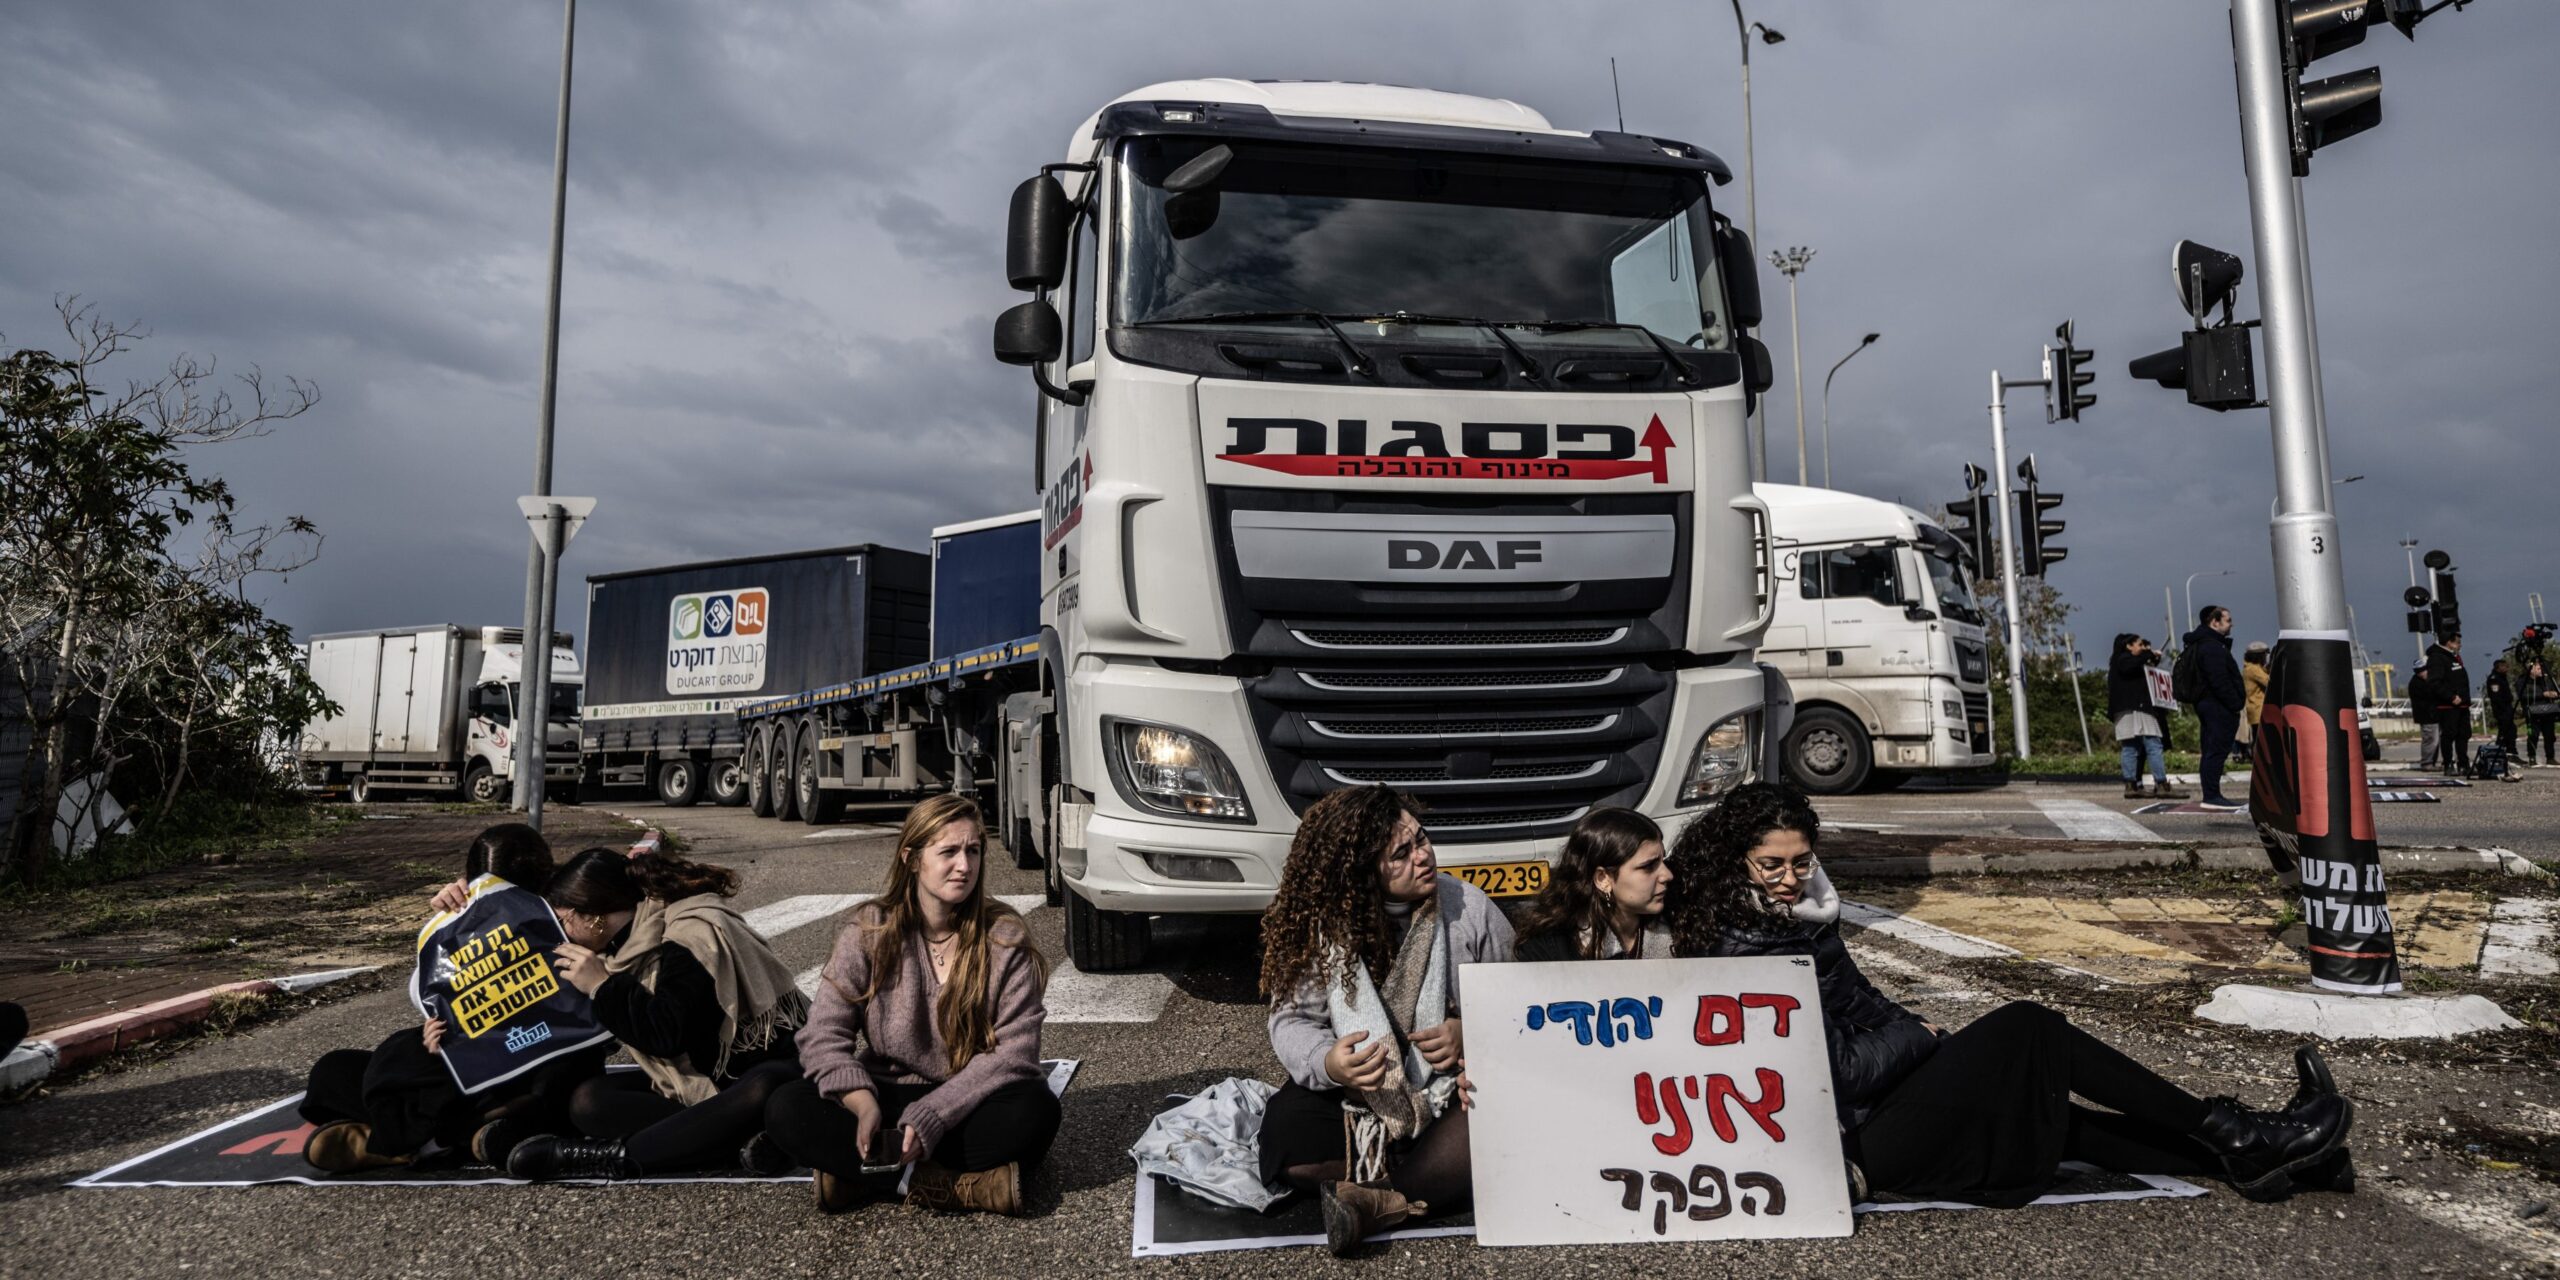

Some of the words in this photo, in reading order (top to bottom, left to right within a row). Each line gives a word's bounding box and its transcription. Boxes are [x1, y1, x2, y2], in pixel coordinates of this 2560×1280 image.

[1226, 418, 1636, 460] פסגות
[1337, 459, 1462, 476] והובלה
[1481, 463, 1570, 478] מינוף
[1387, 540, 1543, 570] DAF
[2311, 536, 2324, 554] 3
[670, 647, 715, 672] דוקרט
[720, 643, 766, 668] קבוצת
[677, 675, 717, 688] DUCART
[720, 674, 754, 686] GROUP
[485, 923, 513, 951] רק
[501, 937, 530, 962] על
[449, 938, 484, 971] לחץ
[490, 957, 541, 993] יחזיר
[460, 986, 491, 1015] את
[466, 975, 555, 1034] החטופים
[1526, 996, 1663, 1048] יהודי
[1694, 992, 1802, 1046] דם
[507, 1022, 549, 1049] תקווה
[1634, 1067, 1786, 1156] אינו
[1600, 1164, 1787, 1236] הפקר
